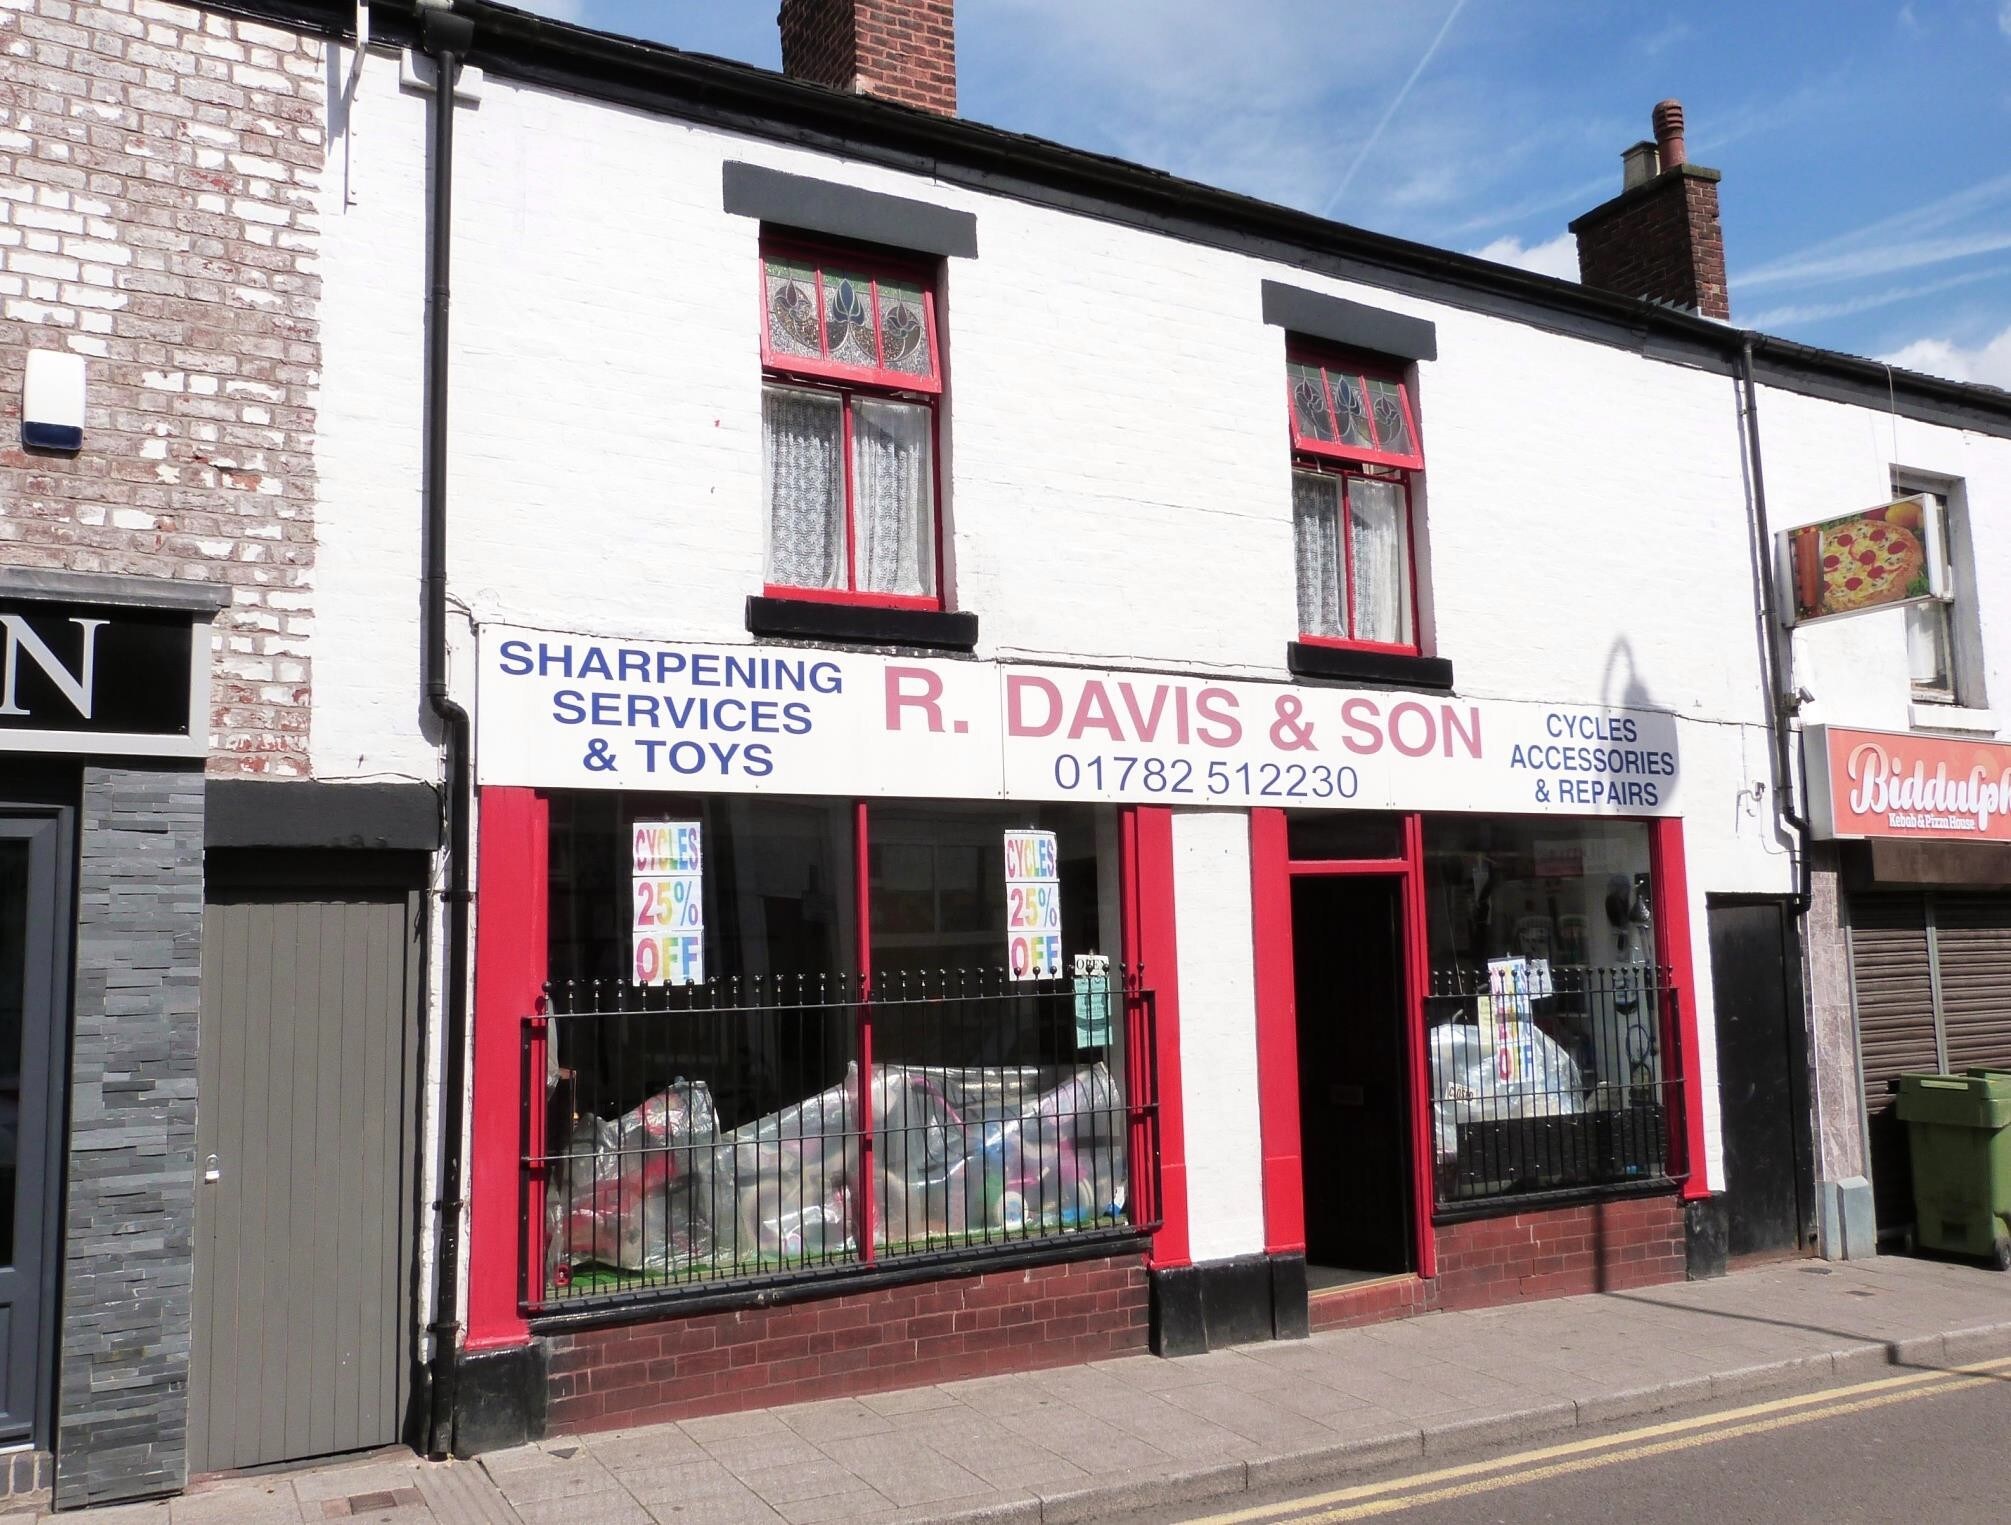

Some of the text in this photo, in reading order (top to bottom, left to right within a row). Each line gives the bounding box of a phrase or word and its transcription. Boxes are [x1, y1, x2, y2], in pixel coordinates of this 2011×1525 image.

[499, 640, 842, 694] SHARPENING
[552, 689, 812, 735] SERVICES
[884, 665, 1483, 759] R. DAVIS & SON
[1546, 713, 1638, 743] CYCLES
[582, 737, 774, 777] & TOYS
[1054, 754, 1358, 799] 01782 512230
[1510, 744, 1675, 776] ACCESSORIES
[1535, 778, 1659, 806] & REPAIRS
[635, 828, 699, 872] CYCLES
[1006, 839, 1055, 878] CYCLES
[637, 881, 699, 926] 25%
[1010, 887, 1057, 927] 25%
[636, 936, 699, 982] OFF
[1011, 935, 1059, 976] OFF
